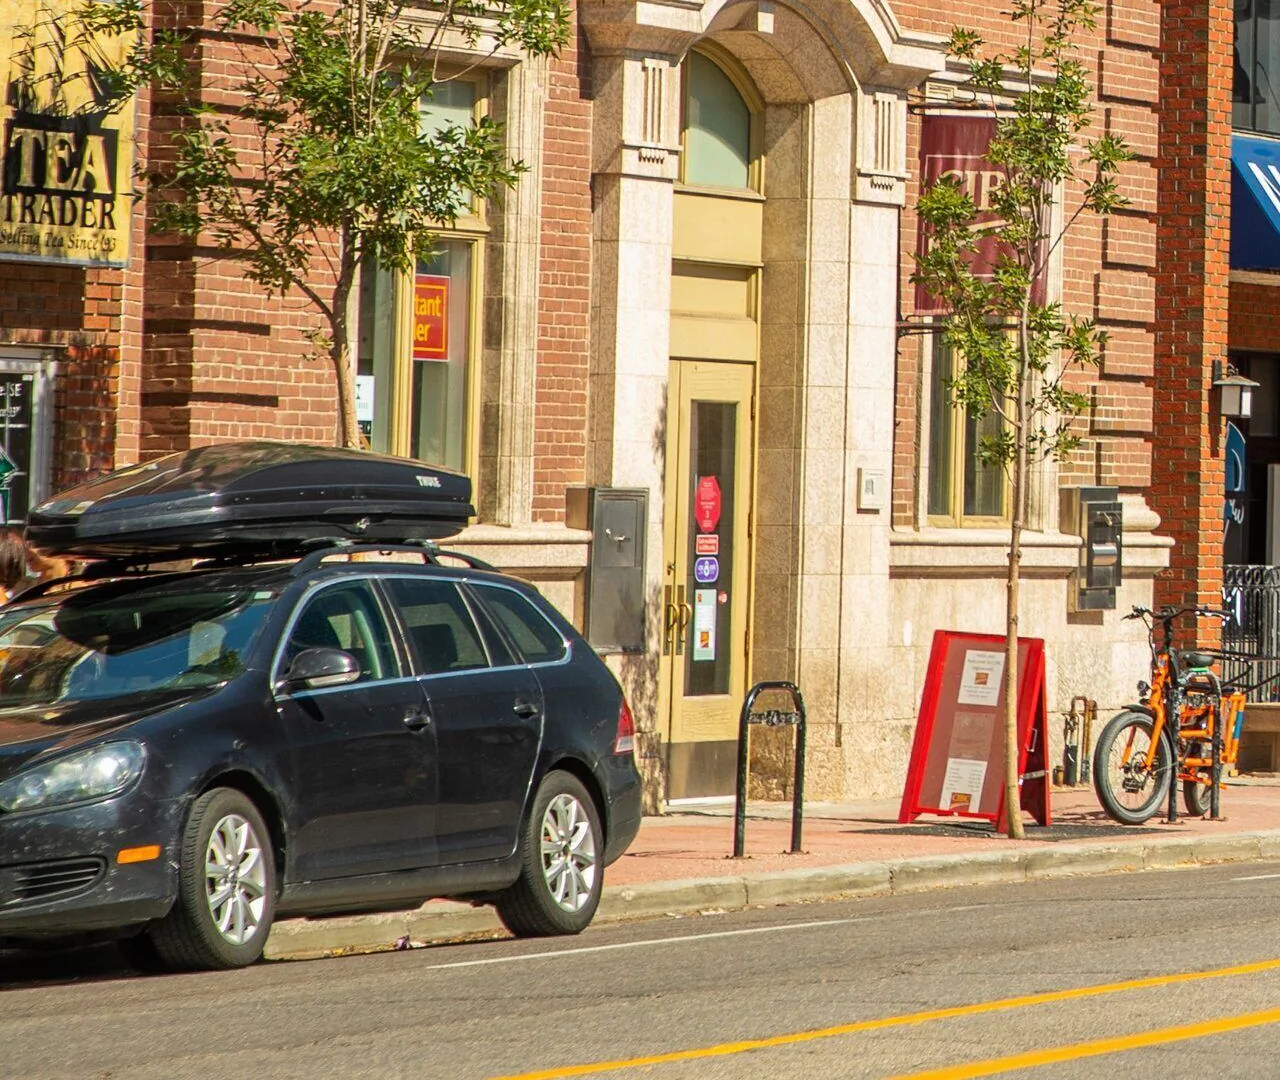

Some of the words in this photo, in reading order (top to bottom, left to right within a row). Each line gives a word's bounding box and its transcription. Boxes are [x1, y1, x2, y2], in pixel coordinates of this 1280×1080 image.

[10, 127, 113, 194] TEA
[0, 193, 116, 230] TRADER
[414, 295, 441, 317] tant
[413, 319, 431, 342] ler
